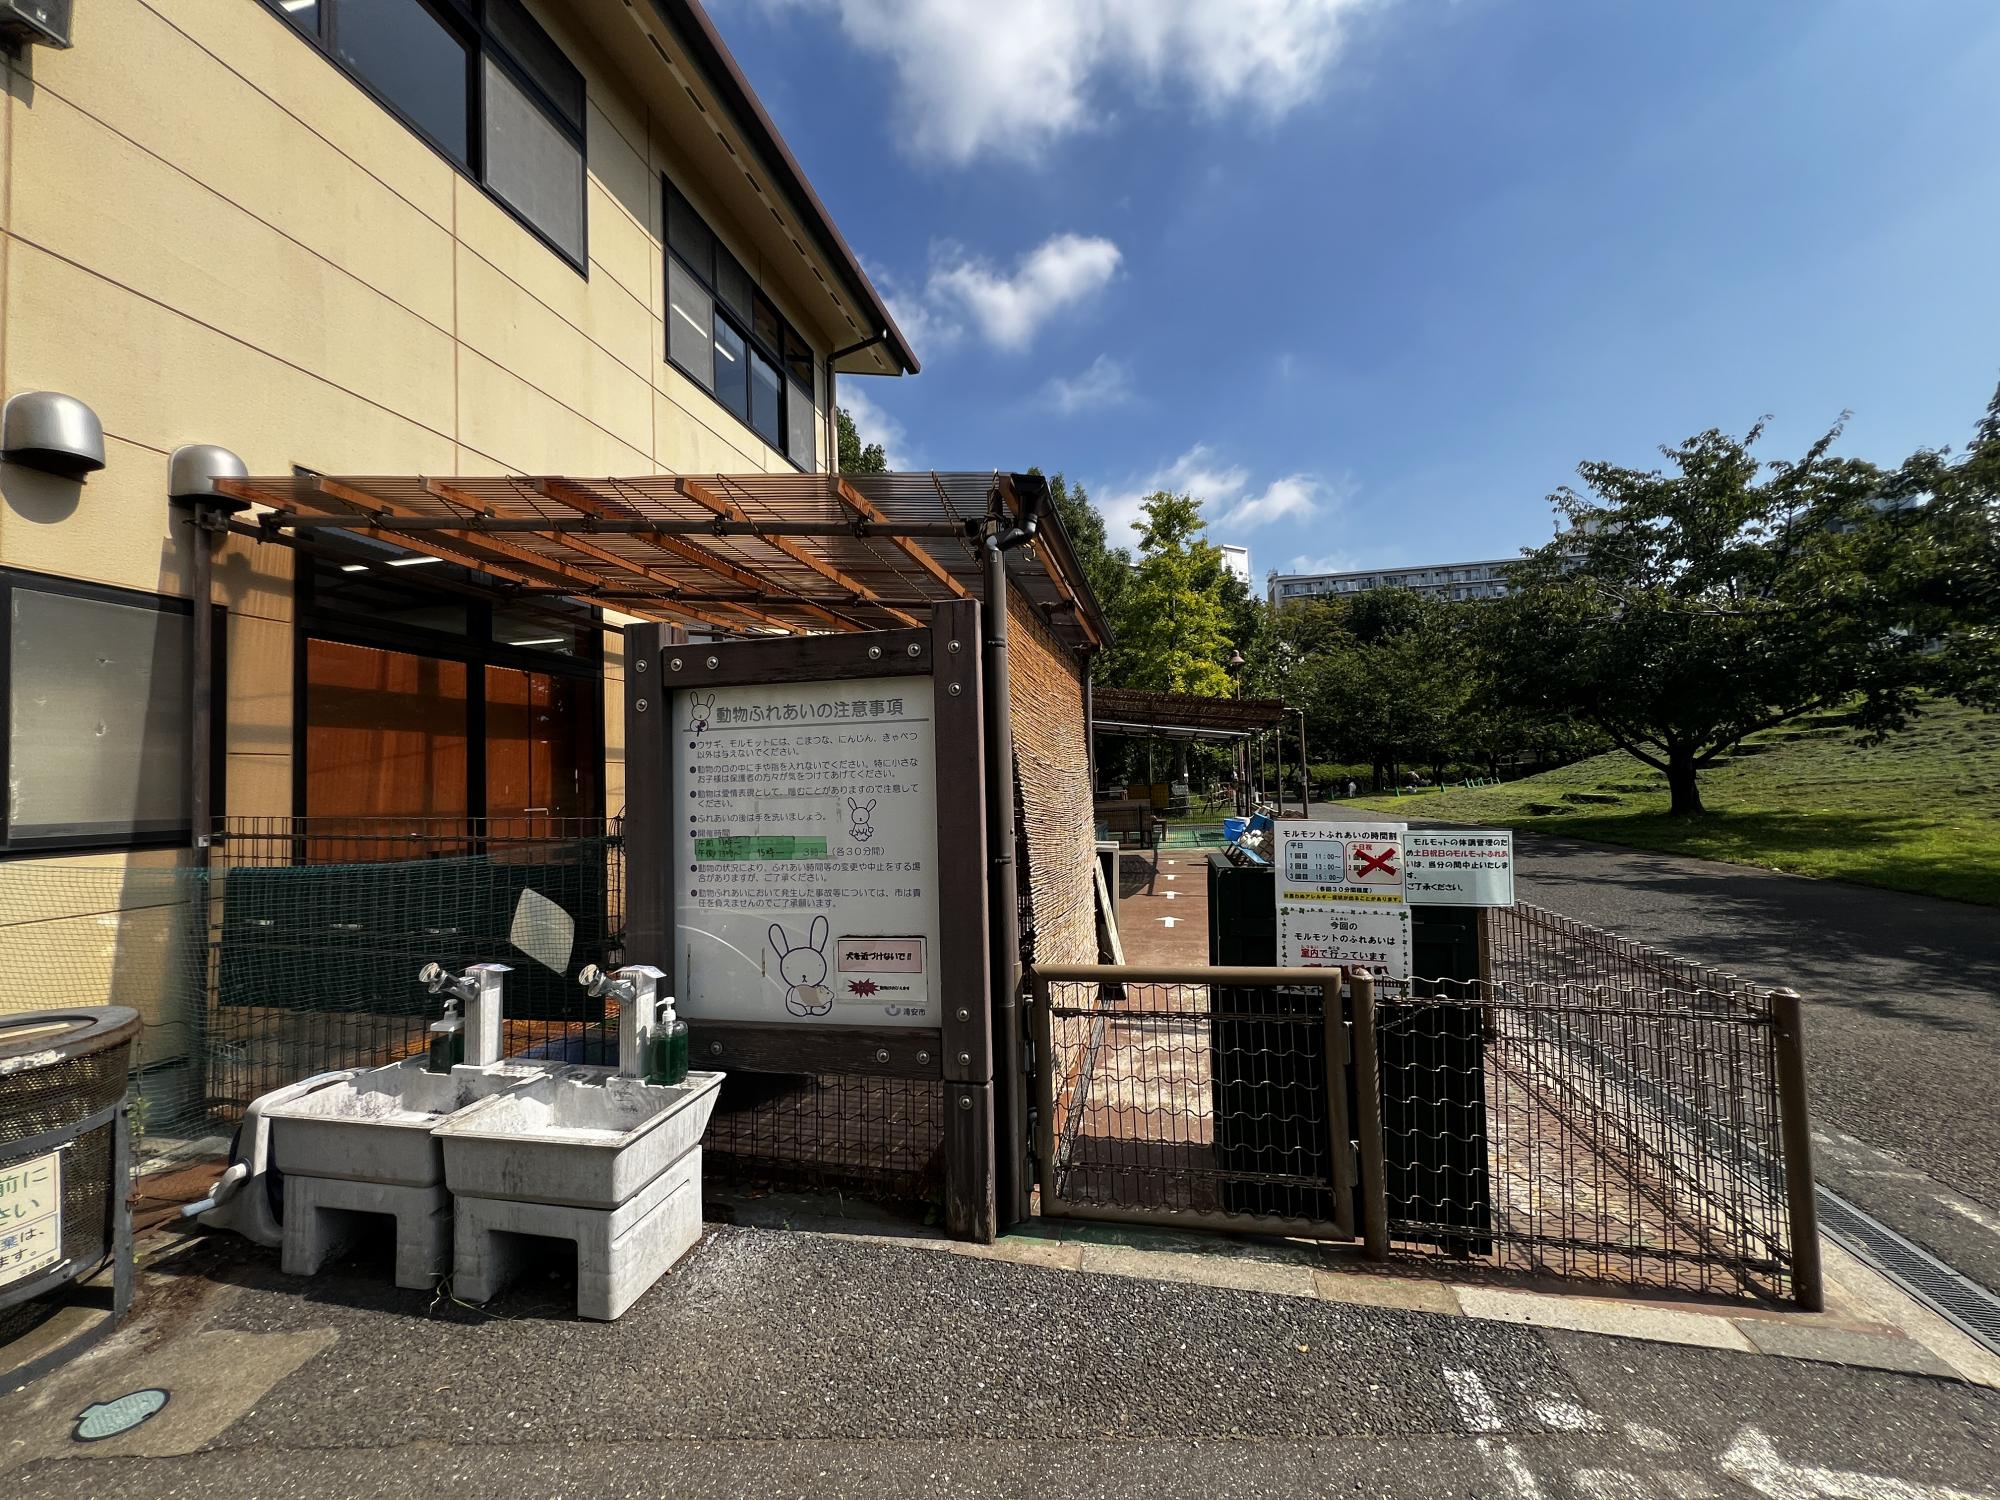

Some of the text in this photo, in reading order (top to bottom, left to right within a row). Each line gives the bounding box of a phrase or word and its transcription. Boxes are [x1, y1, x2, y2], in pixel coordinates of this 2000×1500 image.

[716, 698, 904, 723] 動物ふれあいの注意事項
[697, 748, 800, 759] 以外は与えないでください。
[697, 758, 918, 774] 動物の口の中に手や指を入れないでください。特に小さな
[697, 770, 895, 783] お子様は保護者の方々が気をつけてあげてください。
[698, 800, 734, 808] ください。
[697, 813, 826, 823] ふれあいの後は手を洗いましょう。
[1283, 830, 1398, 841] モルモットふれあいの時間割
[1413, 839, 1508, 847] モルモットの体調管理のた
[1406, 849, 1508, 858] め土日祝日のモルモットふれあ
[698, 862, 921, 873] 動物の状況により、ふれあい時間等の変更や中止をする場
[1406, 860, 1508, 869] いは、当分の間中止いたしま
[698, 873, 828, 882] 合がありますが、ご了承ください。
[1407, 882, 1464, 891] ご了承ください。
[698, 888, 921, 898] 動物ふれあいにおいて発生した事故等については、市は責
[698, 899, 837, 908] 任を負えませんのでご了承願います。
[1330, 921, 1358, 931] 今回の
[1294, 933, 1396, 945] モルモットのふれあいは
[1301, 948, 1387, 961] 室内で行っています
[903, 1008, 926, 1016] 浦安市
